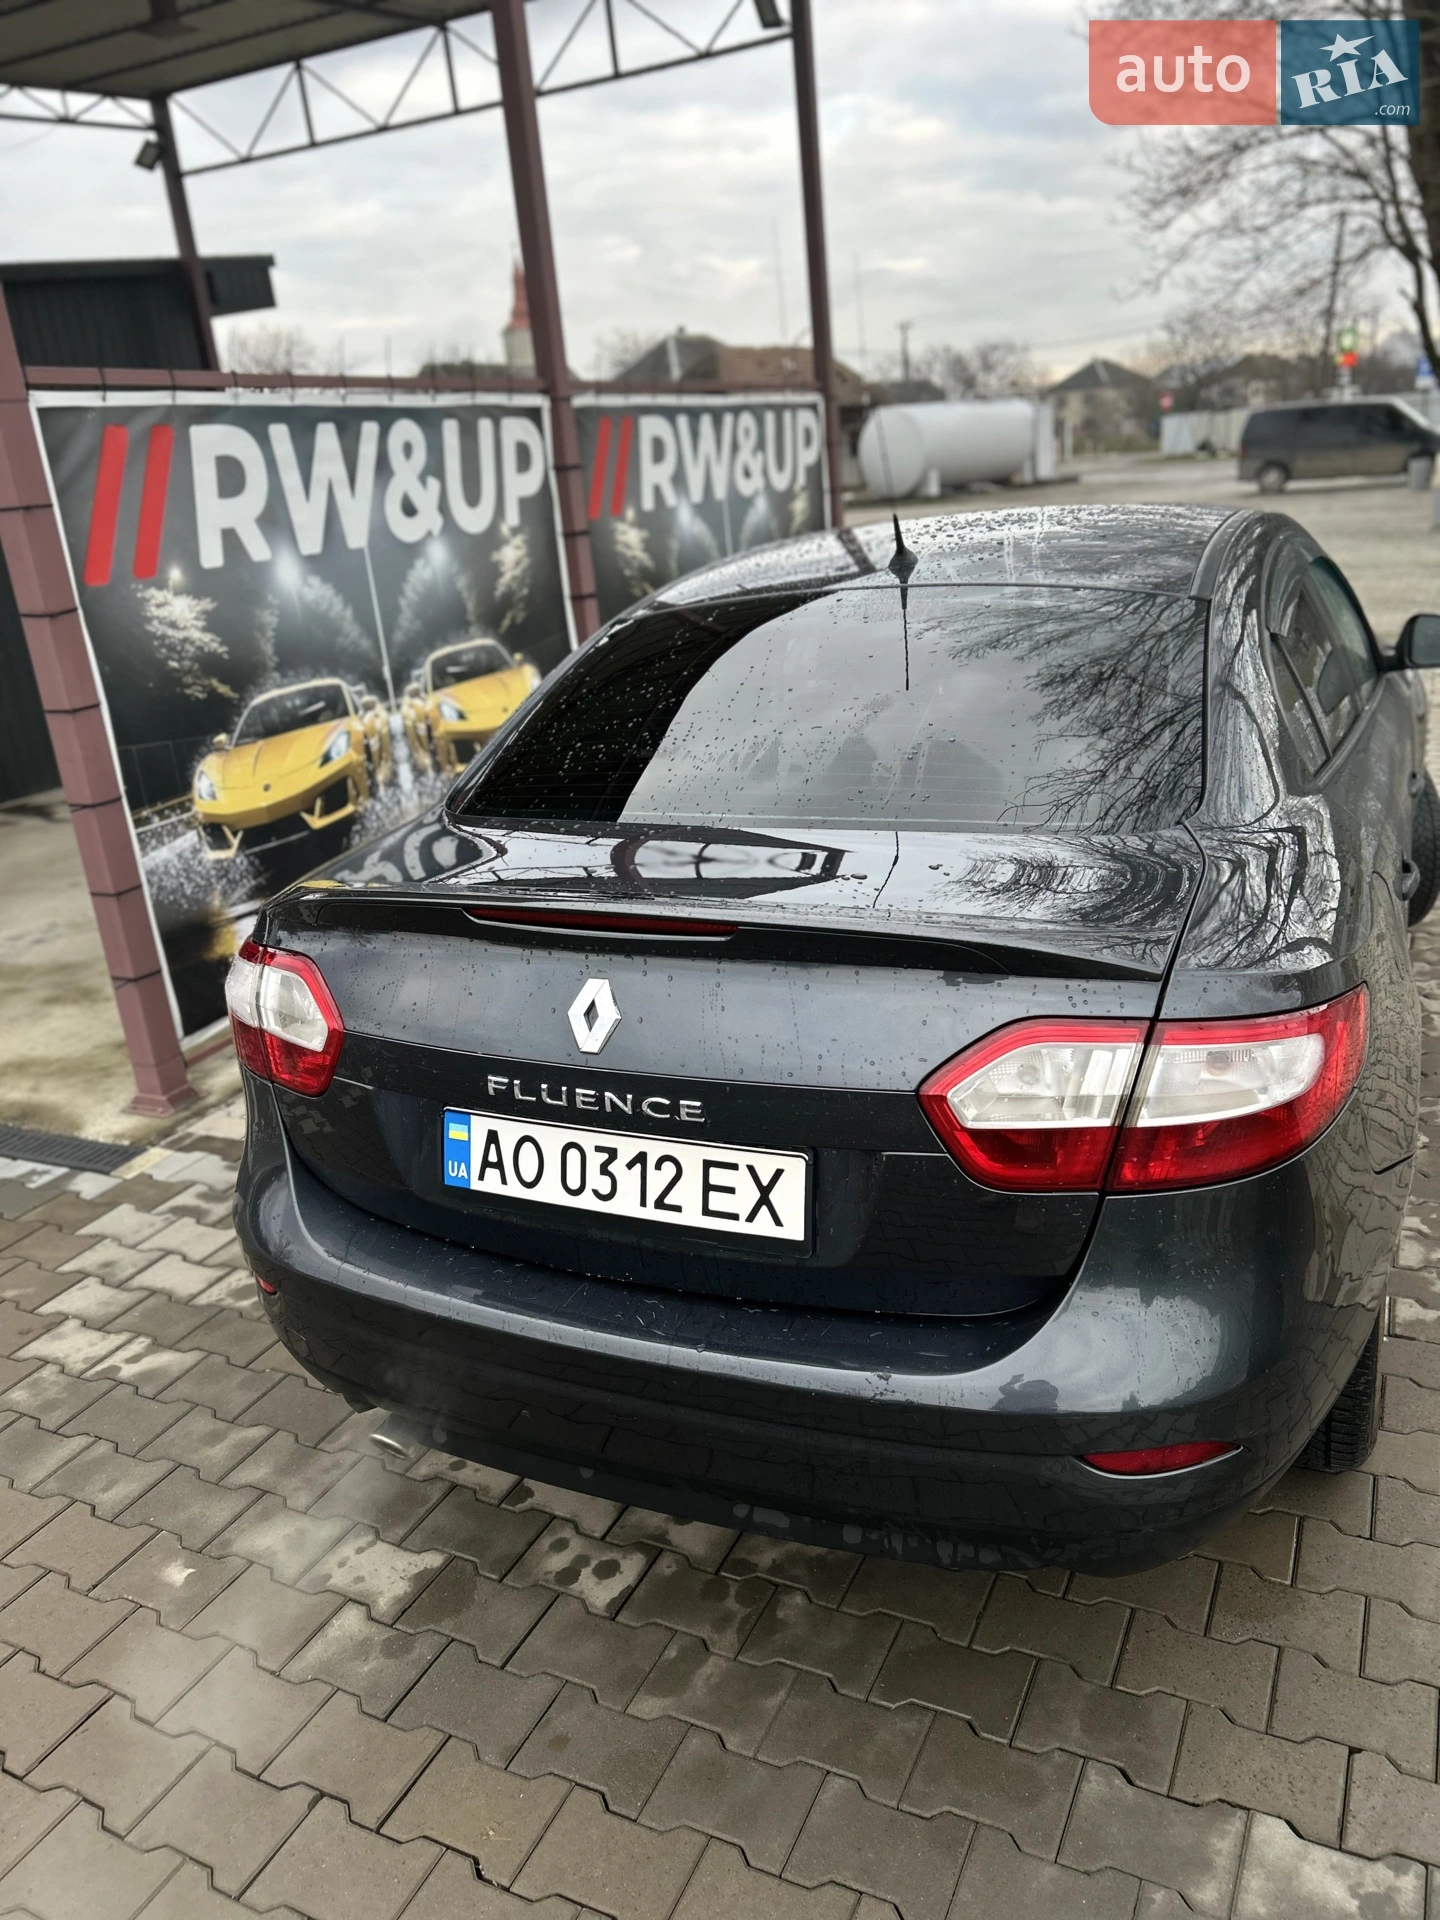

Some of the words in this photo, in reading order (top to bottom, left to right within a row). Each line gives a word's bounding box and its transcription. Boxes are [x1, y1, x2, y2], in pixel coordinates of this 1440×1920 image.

[487, 1074, 706, 1123] FLUENCE
[448, 1160, 468, 1180] UA
[478, 1129, 544, 1189] AO
[560, 1141, 683, 1213] 0312
[702, 1159, 785, 1227] EX
